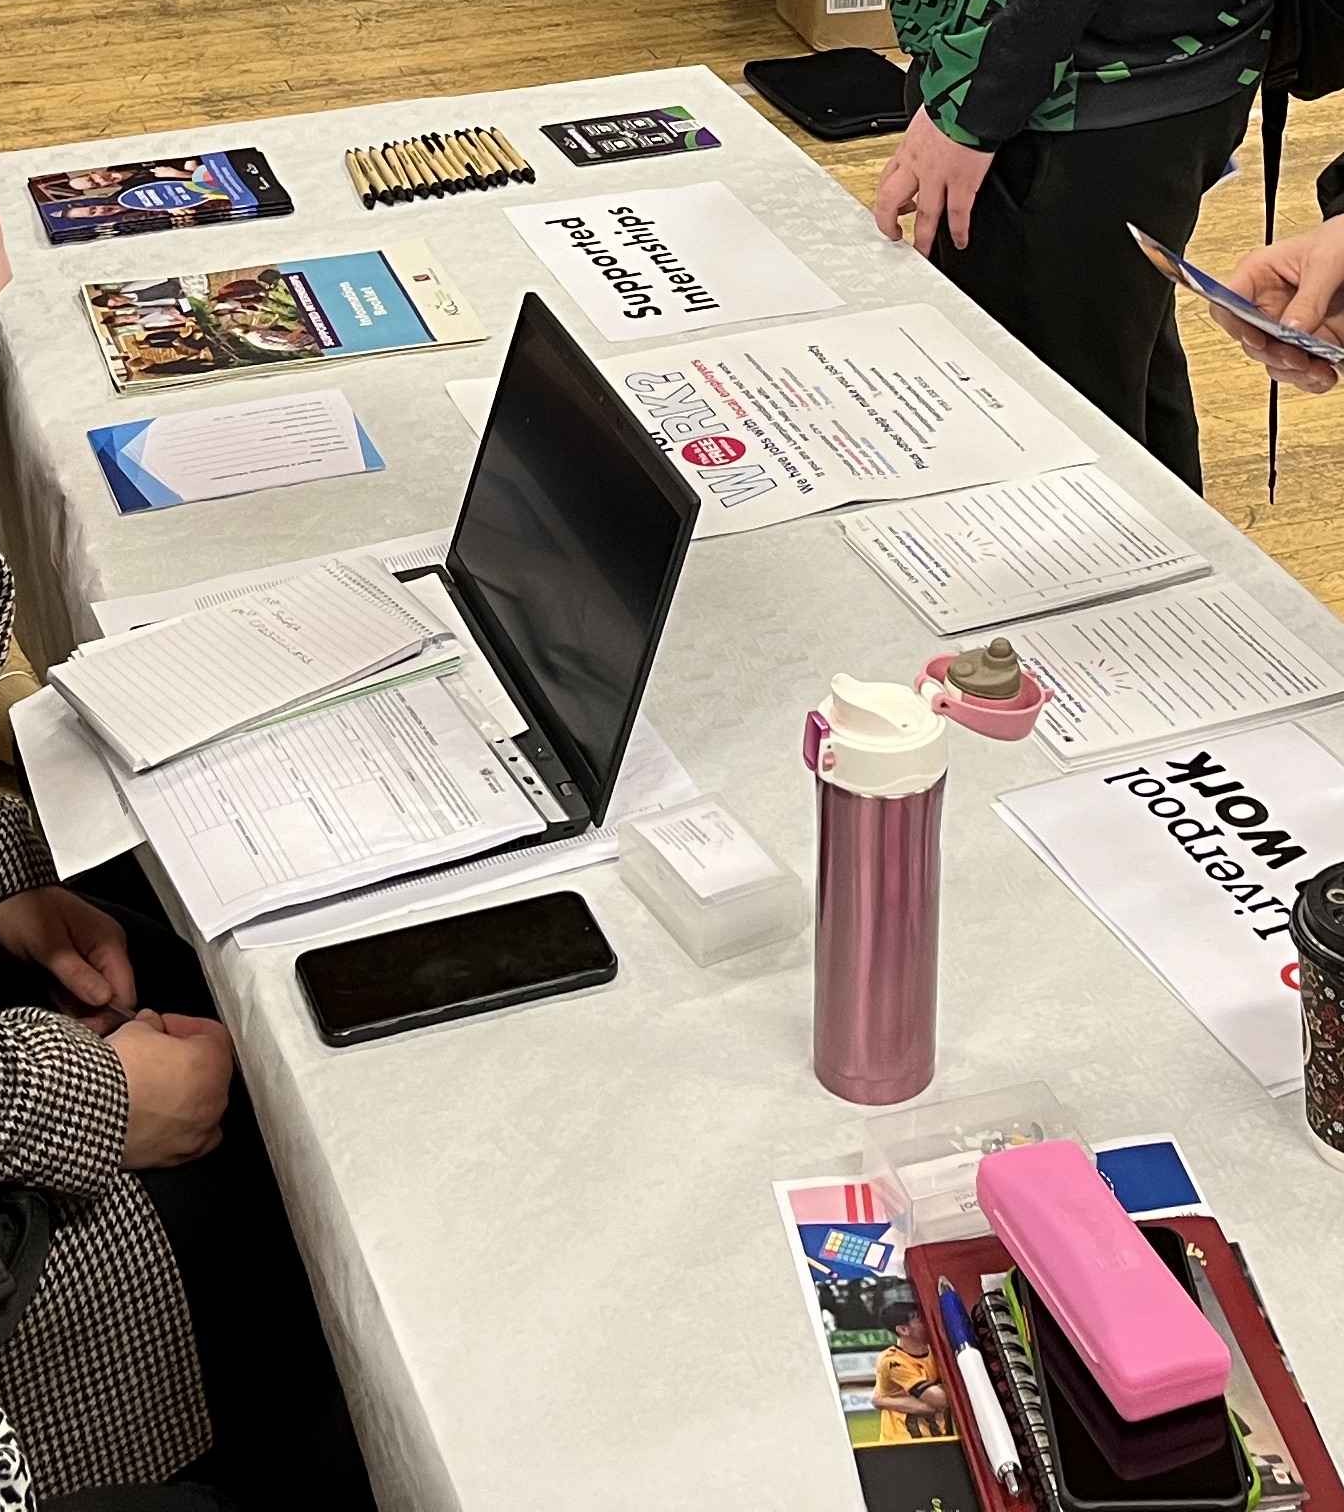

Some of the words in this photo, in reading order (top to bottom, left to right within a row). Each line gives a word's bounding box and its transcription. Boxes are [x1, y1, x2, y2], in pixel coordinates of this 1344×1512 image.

[544, 216, 663, 320] Supported
[607, 206, 721, 314] Internships
[339, 281, 373, 327] Information
[360, 286, 388, 317] Booklet
[804, 344, 832, 363] ready
[686, 358, 733, 397] employers
[821, 364, 843, 375] job
[832, 375, 855, 388] you
[720, 398, 749, 418] local
[844, 389, 872, 408] make
[863, 408, 879, 416] to
[739, 418, 766, 437] with
[870, 416, 896, 432] help
[696, 436, 730, 464] FREE
[756, 436, 786, 456] jobs
[886, 432, 915, 453] other
[773, 456, 803, 478] have
[905, 453, 930, 470] Plus
[791, 478, 816, 494] We
[1166, 751, 1308, 870] work
[1103, 767, 1292, 941] Liverpool
